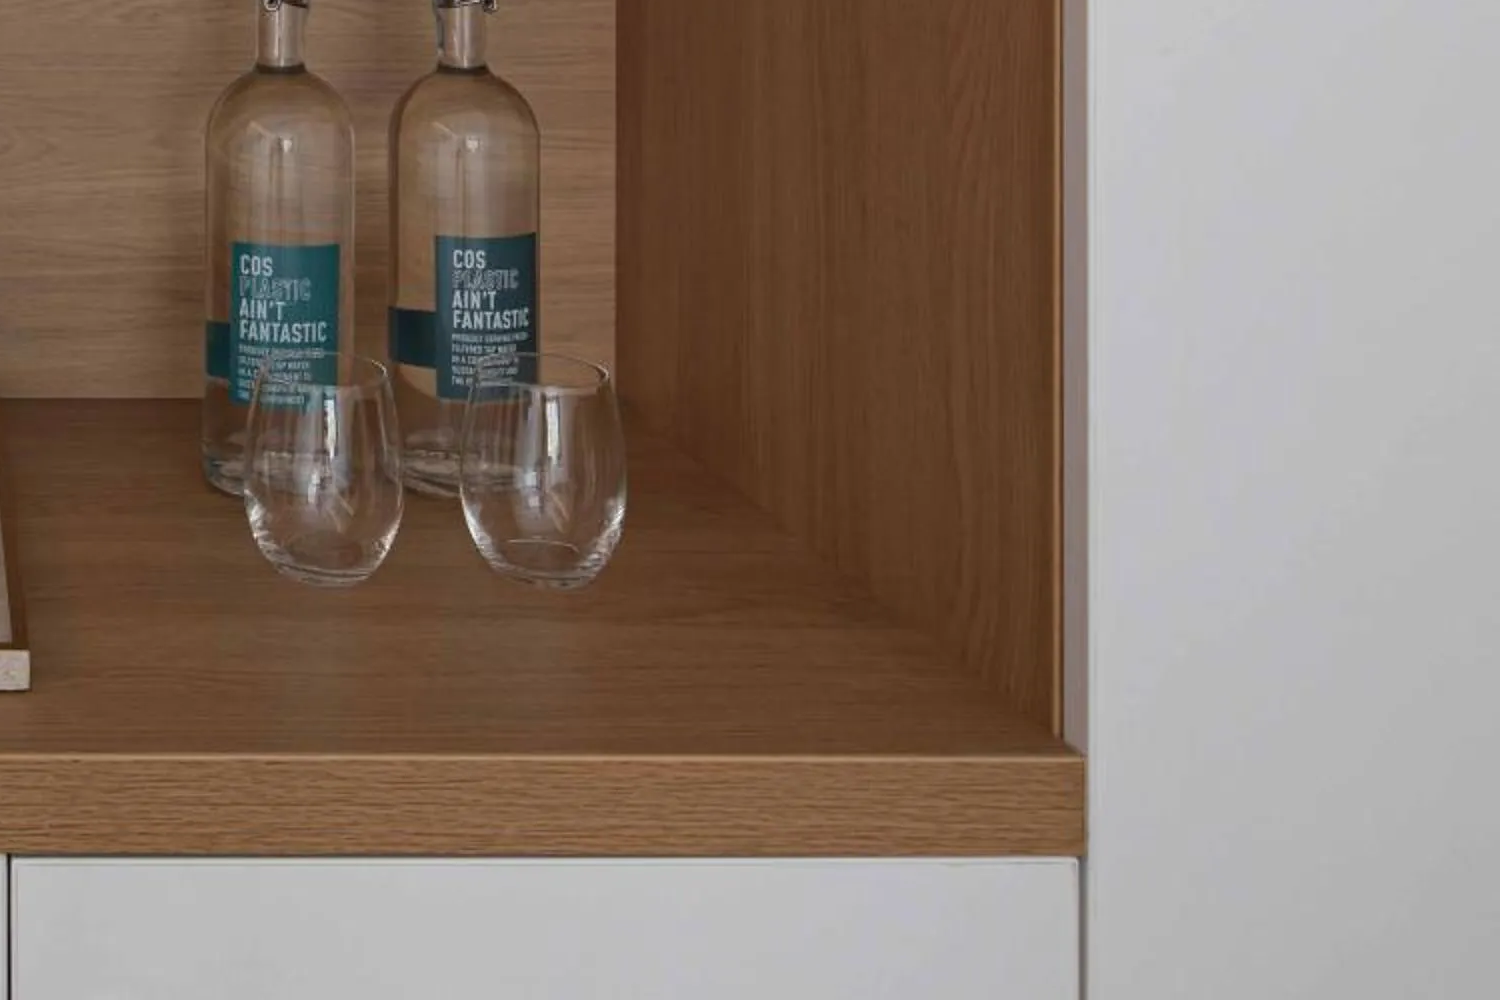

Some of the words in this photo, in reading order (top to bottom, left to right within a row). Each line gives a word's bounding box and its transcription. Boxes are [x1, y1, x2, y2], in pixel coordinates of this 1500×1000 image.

[239, 253, 273, 277] COS
[452, 249, 487, 269] COS
[238, 275, 312, 301] PLASTIC
[452, 267, 520, 290] PLASTIC
[239, 297, 286, 321] AIN'T
[451, 289, 497, 310] AIN'T
[452, 307, 529, 329] FANTASTIC
[239, 318, 328, 343] FANTASTIC
